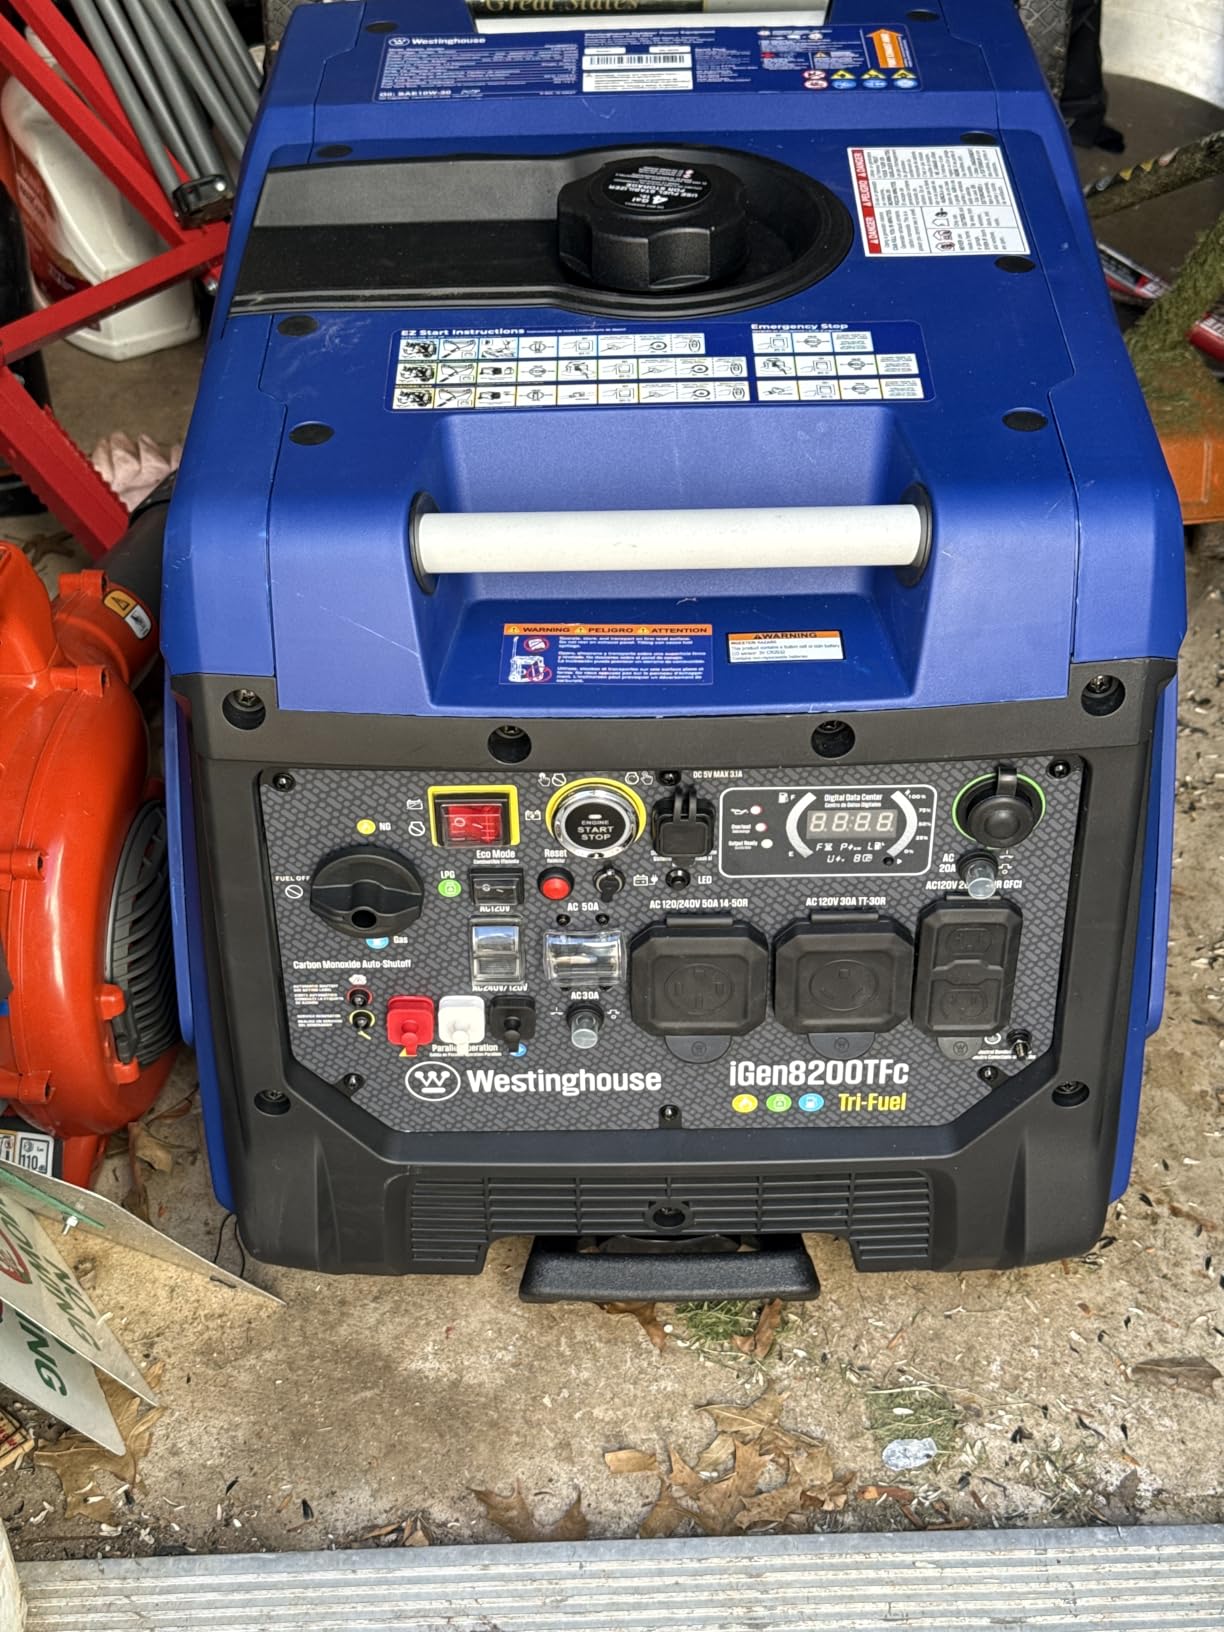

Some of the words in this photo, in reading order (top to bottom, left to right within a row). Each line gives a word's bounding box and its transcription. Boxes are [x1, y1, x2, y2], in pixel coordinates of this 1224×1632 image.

[411, 38, 486, 46] Westinghouse
[652, 195, 669, 204] 4
[452, 328, 525, 336] Instructions
[750, 324, 817, 332] Emergency
[588, 626, 634, 634] PELIGRO
[650, 626, 708, 634] ATTENTION
[378, 822, 391, 831] NG
[476, 850, 490, 858] Eco
[492, 850, 516, 858] Mode
[544, 850, 568, 858] Reset
[942, 854, 954, 862] AC
[939, 864, 956, 872] 20A
[440, 870, 456, 879] LPG
[698, 876, 712, 884] LED
[926, 880, 958, 890] AC120V
[1004, 880, 1022, 888] GFCI
[650, 900, 662, 908] AC
[662, 899, 700, 910] 120/240V
[702, 899, 719, 908] 50A
[720, 898, 748, 908] 14-50R
[806, 898, 818, 906] AC
[818, 897, 839, 906] 120V
[840, 897, 857, 906] 30A
[858, 896, 886, 906] TT-30R
[568, 903, 578, 912] AC
[581, 902, 600, 911] 50A
[293, 961, 322, 970] Carbon
[322, 960, 361, 969] Monoxide
[362, 960, 412, 968] Auto-Shutoff
[730, 1059, 910, 1086] iGen8200TFc
[466, 1069, 662, 1096] Westinghouse
[838, 1092, 906, 1112] Tri-Fuel
[21, 1154, 38, 1170] 110
[42, 1256, 96, 1319] NO
